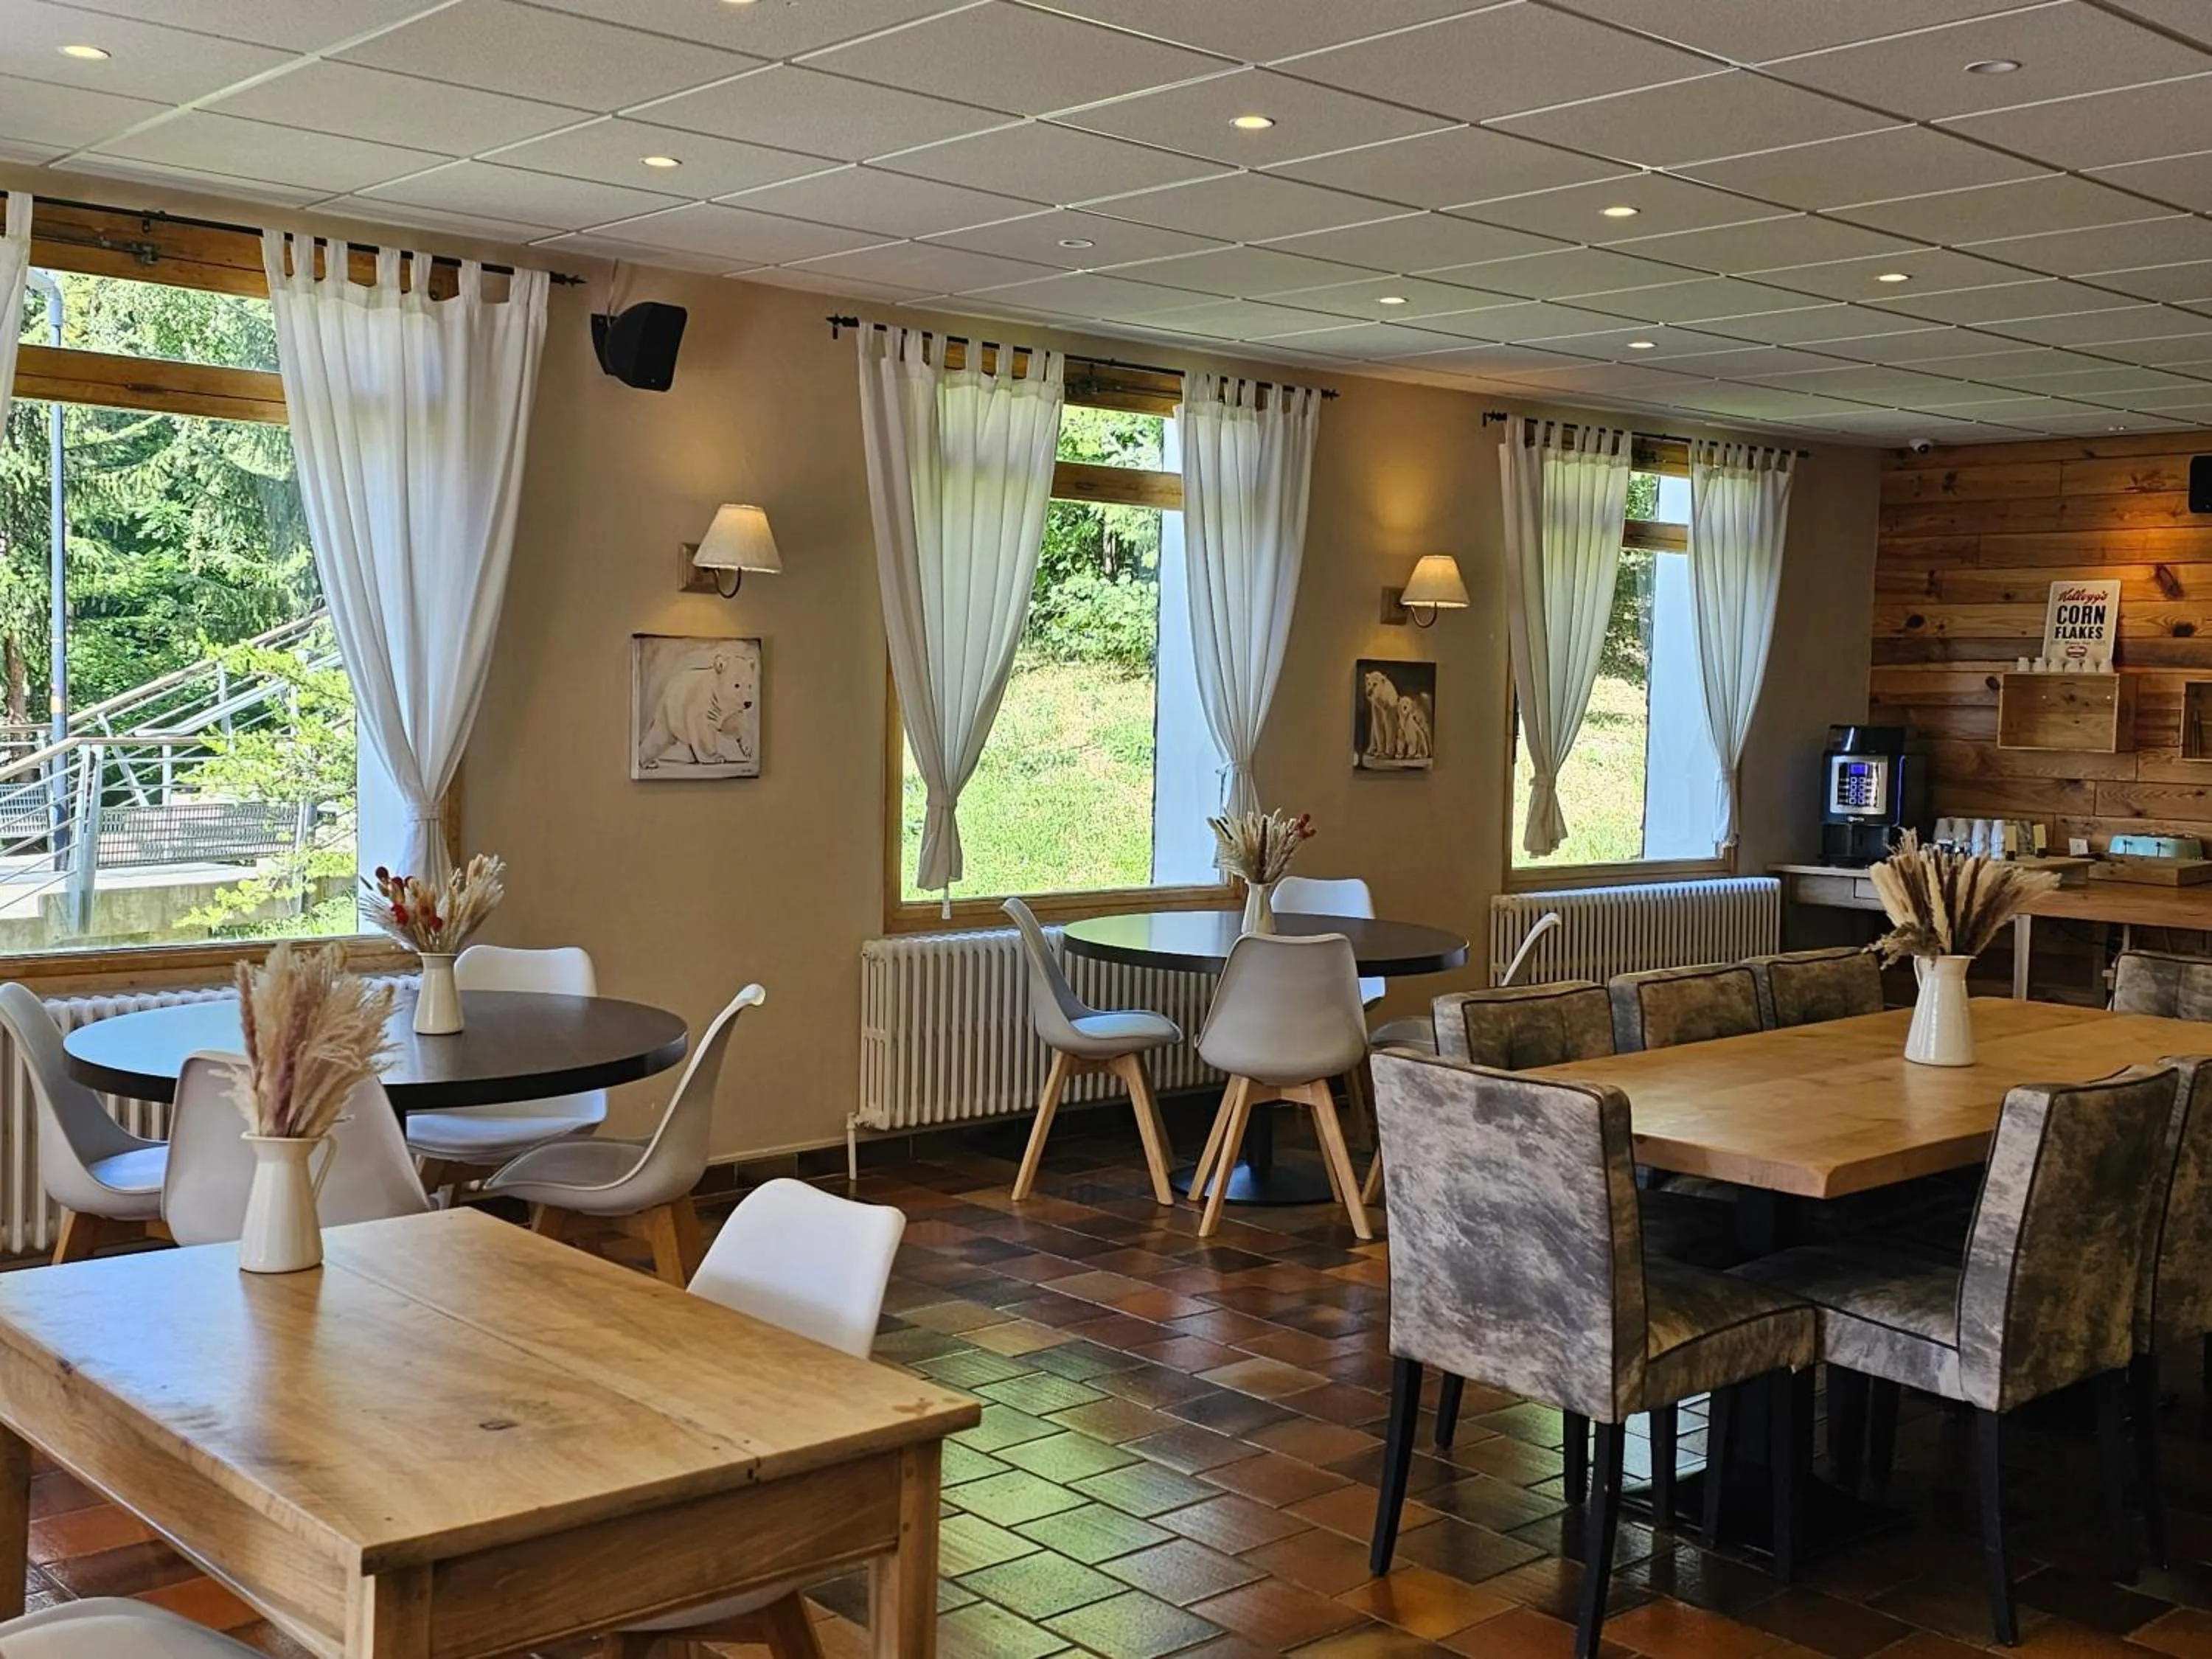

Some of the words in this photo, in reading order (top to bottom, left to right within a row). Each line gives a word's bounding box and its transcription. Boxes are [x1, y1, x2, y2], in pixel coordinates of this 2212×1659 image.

[2058, 588, 2109, 605] Kellogg's
[2056, 605, 2107, 625] CORN
[2054, 626, 2104, 639] FLAKES
